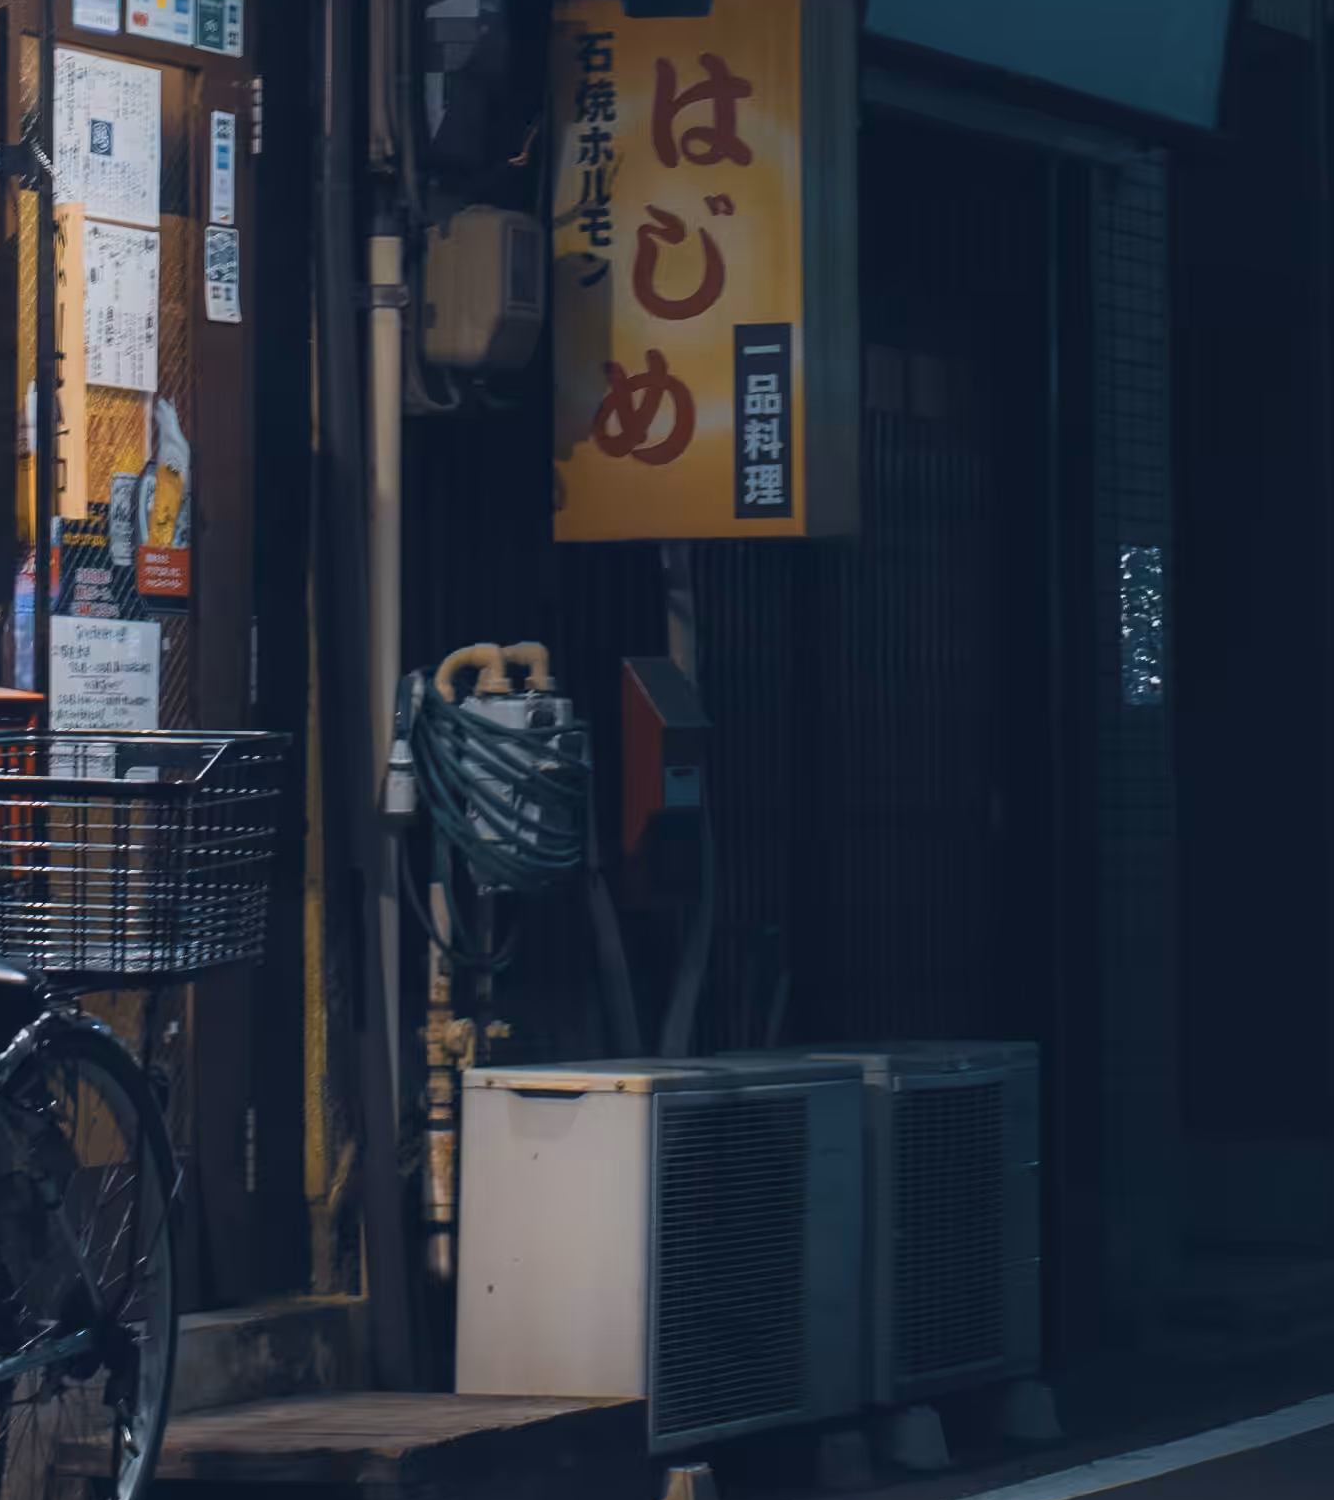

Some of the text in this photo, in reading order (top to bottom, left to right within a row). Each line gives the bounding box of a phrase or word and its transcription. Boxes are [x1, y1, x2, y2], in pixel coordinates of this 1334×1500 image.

[575, 30, 616, 287] 石焼ホルモン
[592, 52, 754, 467] はじめ
[743, 342, 785, 506] 一品料理
